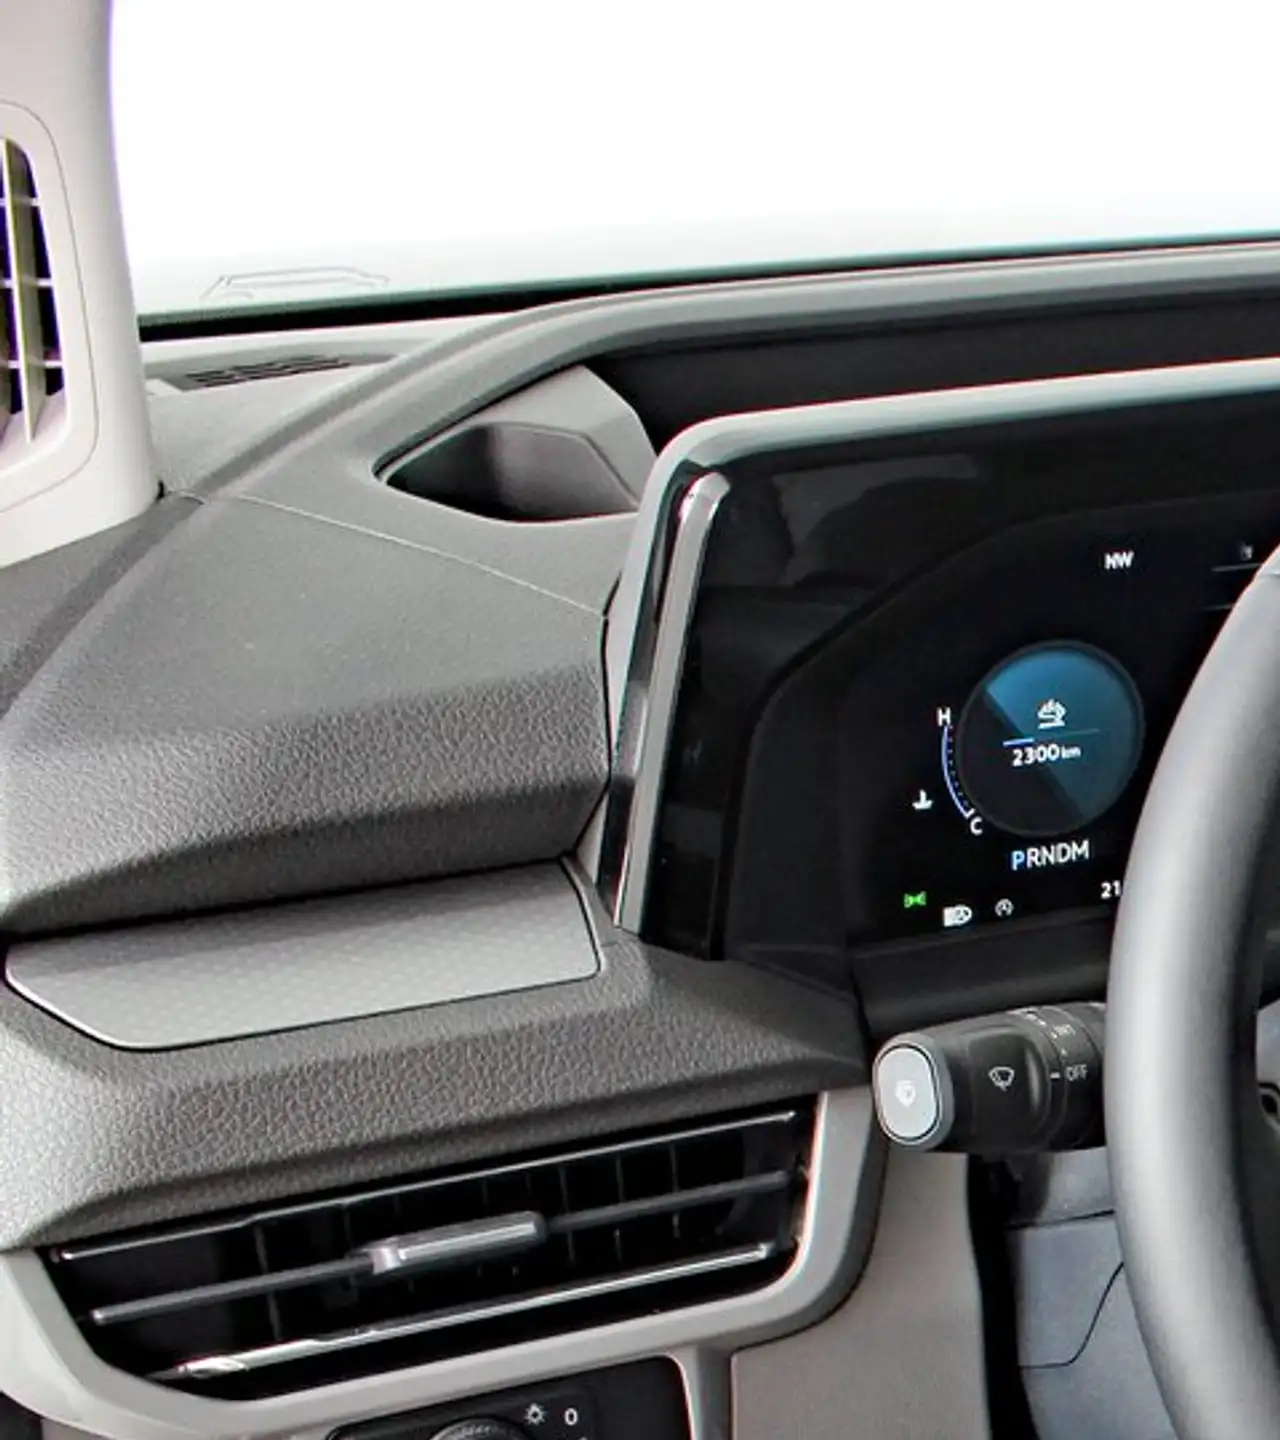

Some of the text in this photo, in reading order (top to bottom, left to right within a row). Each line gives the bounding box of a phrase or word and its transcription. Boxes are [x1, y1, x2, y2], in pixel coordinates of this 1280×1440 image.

[1104, 550, 1134, 569] NW
[937, 708, 951, 725] H
[1012, 744, 1081, 766] 2300 km
[970, 818, 983, 834] C
[1010, 840, 1091, 871] PRNDM
[1065, 1064, 1088, 1082] OFF
